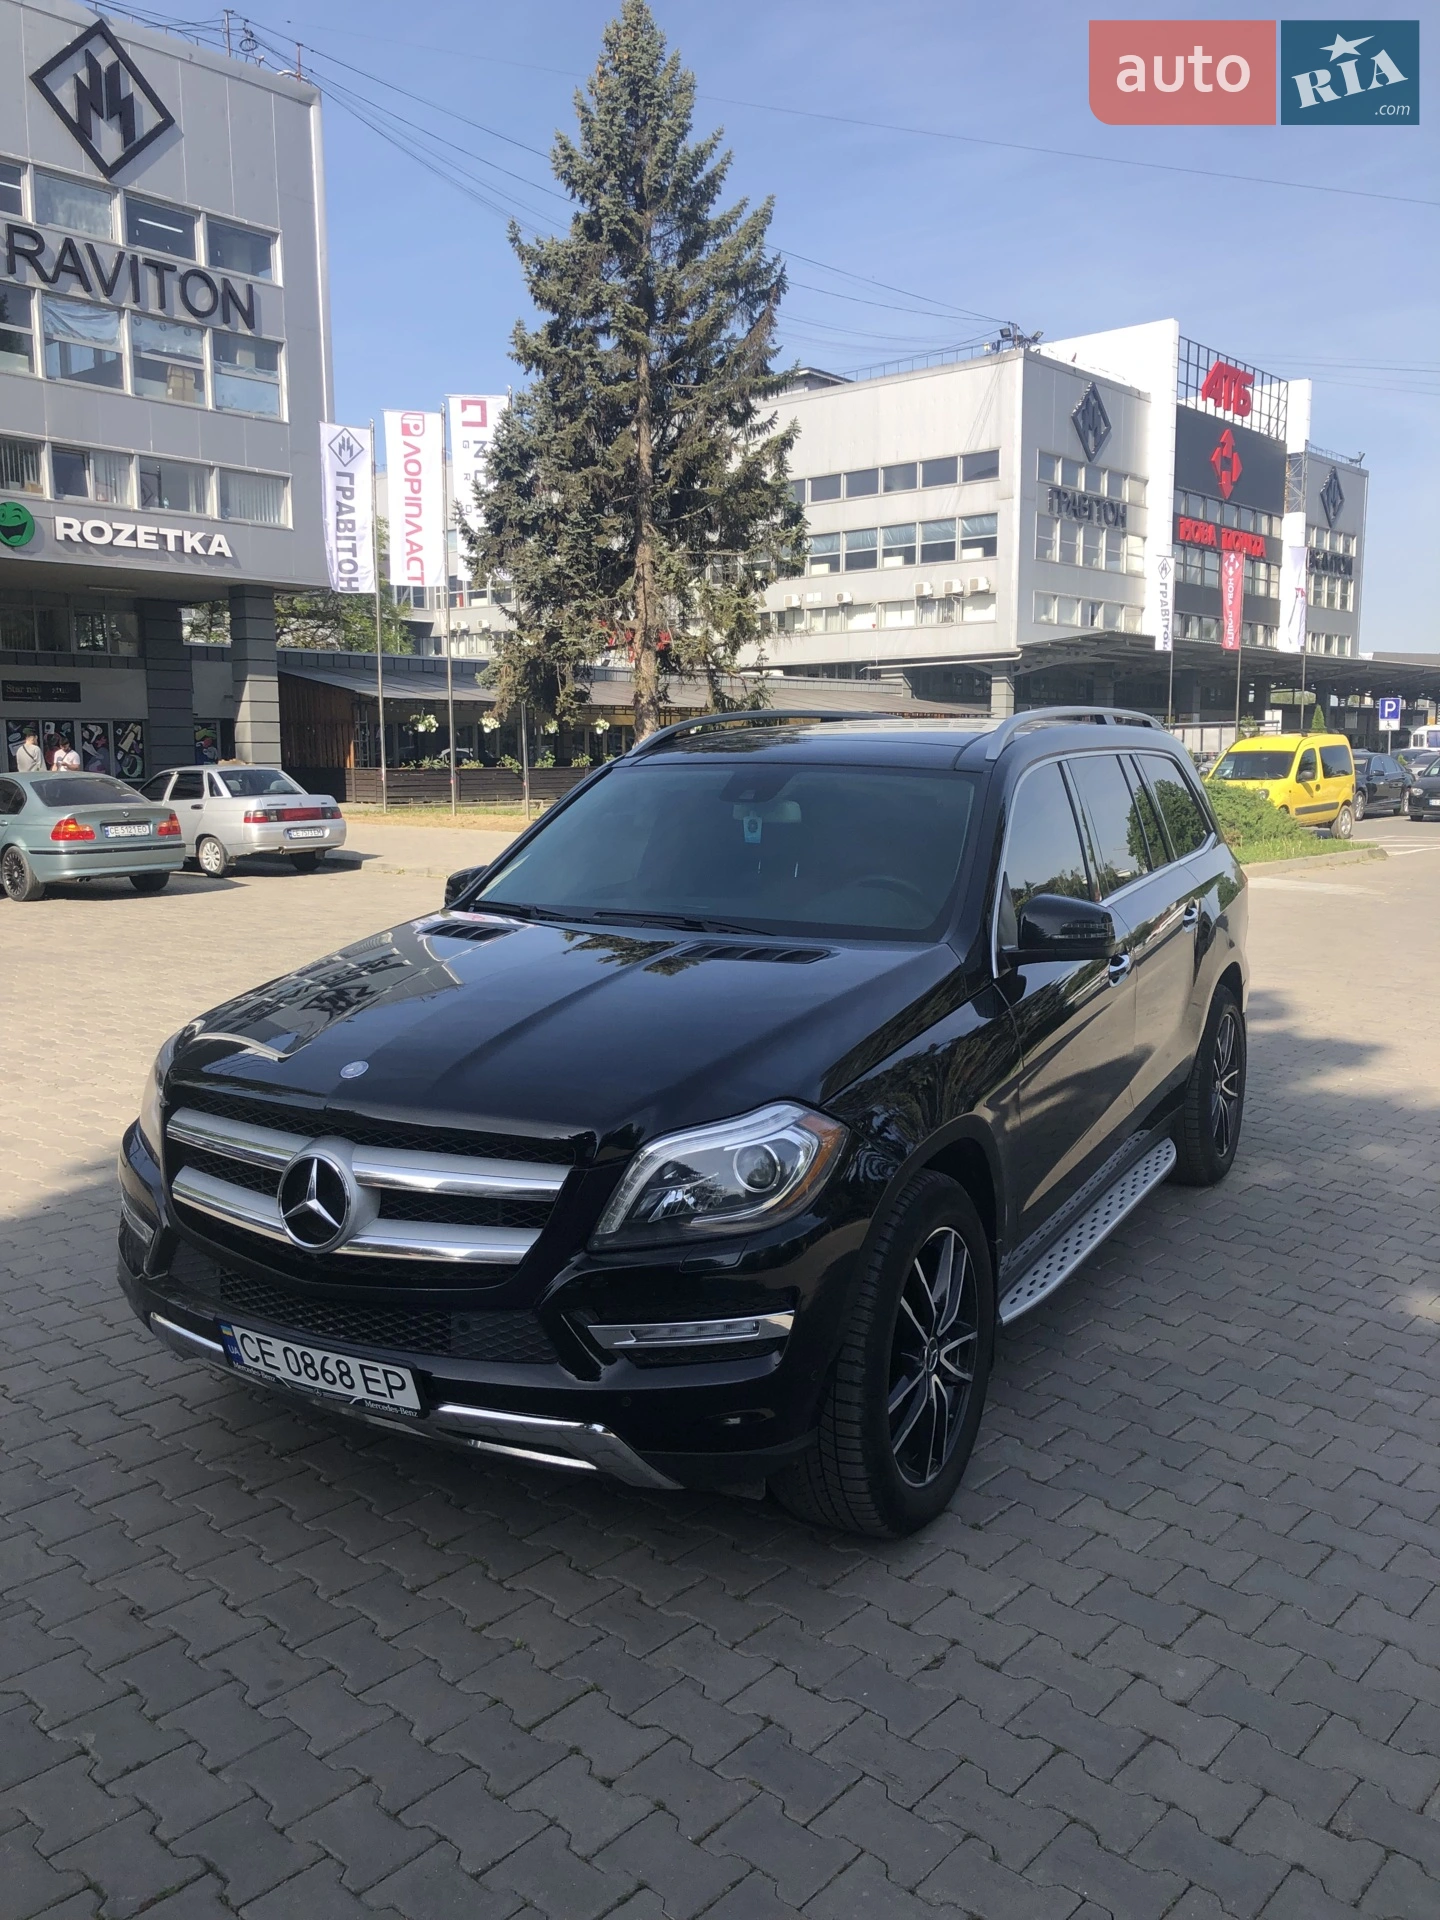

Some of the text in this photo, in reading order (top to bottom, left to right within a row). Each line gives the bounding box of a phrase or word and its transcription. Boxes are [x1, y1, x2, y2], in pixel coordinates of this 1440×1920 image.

[1202, 360, 1255, 417] АТБ
[55, 515, 233, 559] ROZETKA
[336, 471, 360, 592] ГРАВІТОН
[1384, 701, 1396, 718] P
[228, 1344, 241, 1357] UA
[239, 1333, 406, 1399] CE 0868 EP
[364, 1400, 418, 1417] Mercedes-Benz
